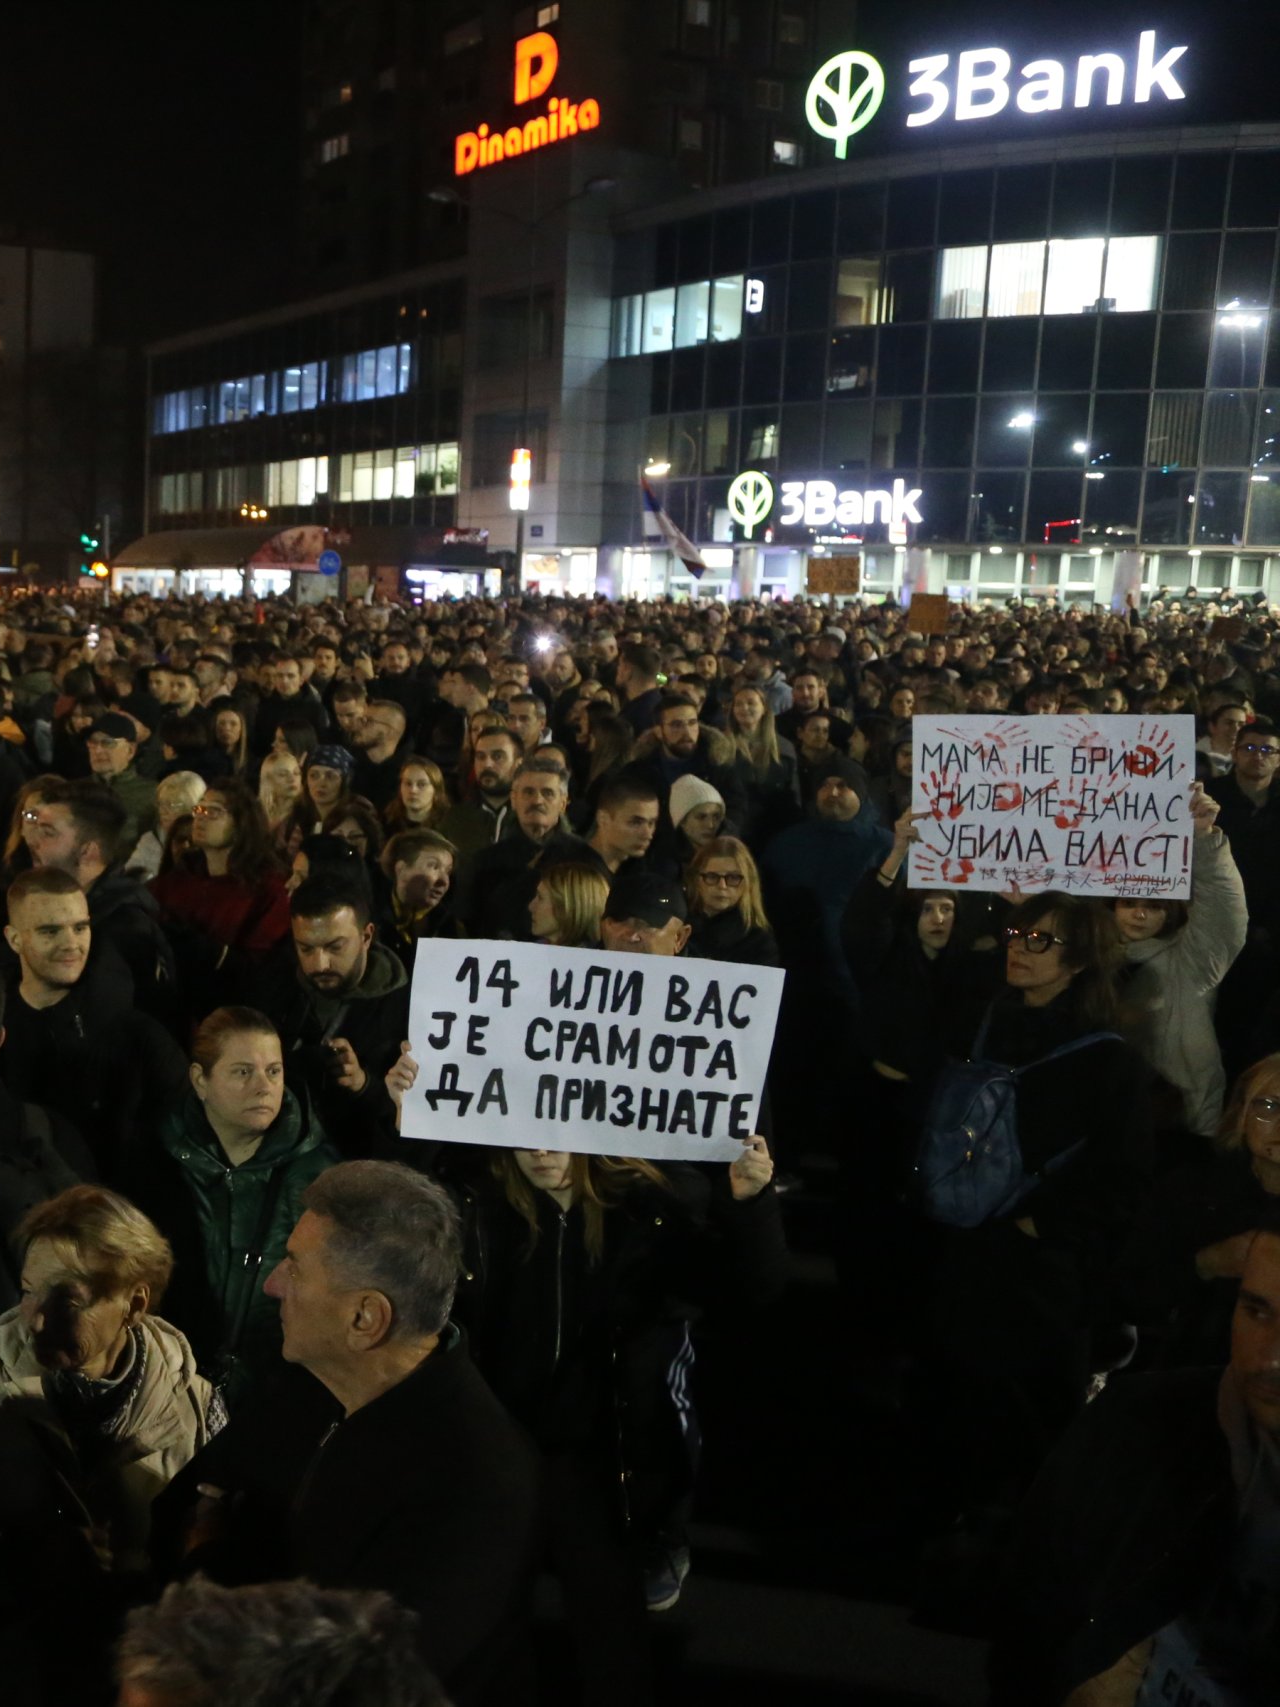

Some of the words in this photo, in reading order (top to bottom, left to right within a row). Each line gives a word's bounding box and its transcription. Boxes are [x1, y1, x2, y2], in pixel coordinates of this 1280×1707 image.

[906, 30, 1188, 127] 3Bank
[455, 98, 599, 176] Dinamika
[780, 478, 923, 525] 3Bank
[920, 743, 1003, 774] МАМА
[1023, 745, 1055, 774] НЕ
[1072, 746, 1173, 780] БРИНИ
[937, 782, 1008, 812] НИЈЕ
[1022, 784, 1059, 817] МЕ
[938, 824, 1048, 863] УБИЛА
[1065, 830, 1189, 873] ВЛАСТ!
[456, 956, 519, 1007] 14
[549, 965, 644, 1016] ИЛИ
[665, 975, 757, 1029] ВАС
[428, 1012, 490, 1056] ЈЕ
[524, 1017, 738, 1080] СРАМОТА
[424, 1063, 509, 1117] ДА
[535, 1074, 753, 1140] ПРИЗНАТЕ
